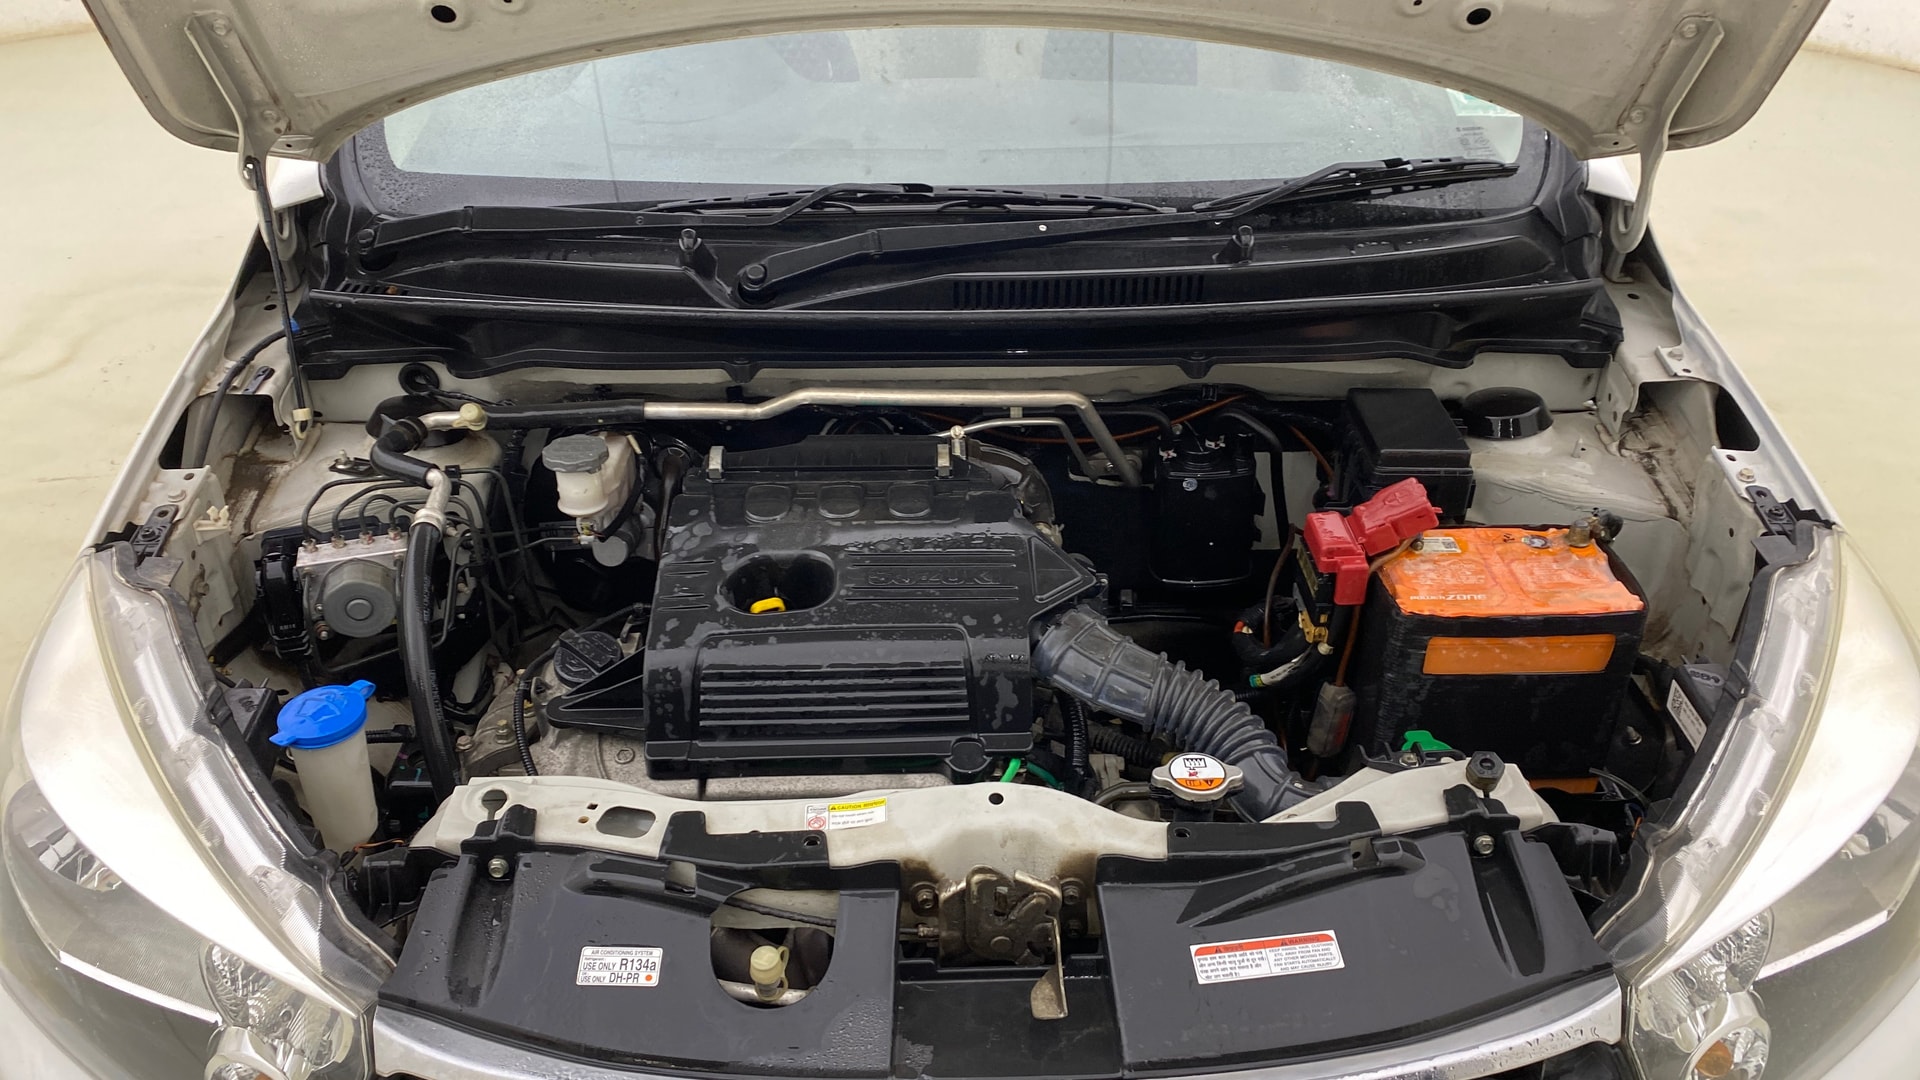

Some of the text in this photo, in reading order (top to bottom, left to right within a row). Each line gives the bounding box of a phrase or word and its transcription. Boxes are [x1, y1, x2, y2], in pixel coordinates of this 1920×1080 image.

[867, 568, 1000, 585] SUZUKI
[583, 958, 656, 970] USE ONLY R134a
[609, 973, 639, 982] DH-PR
